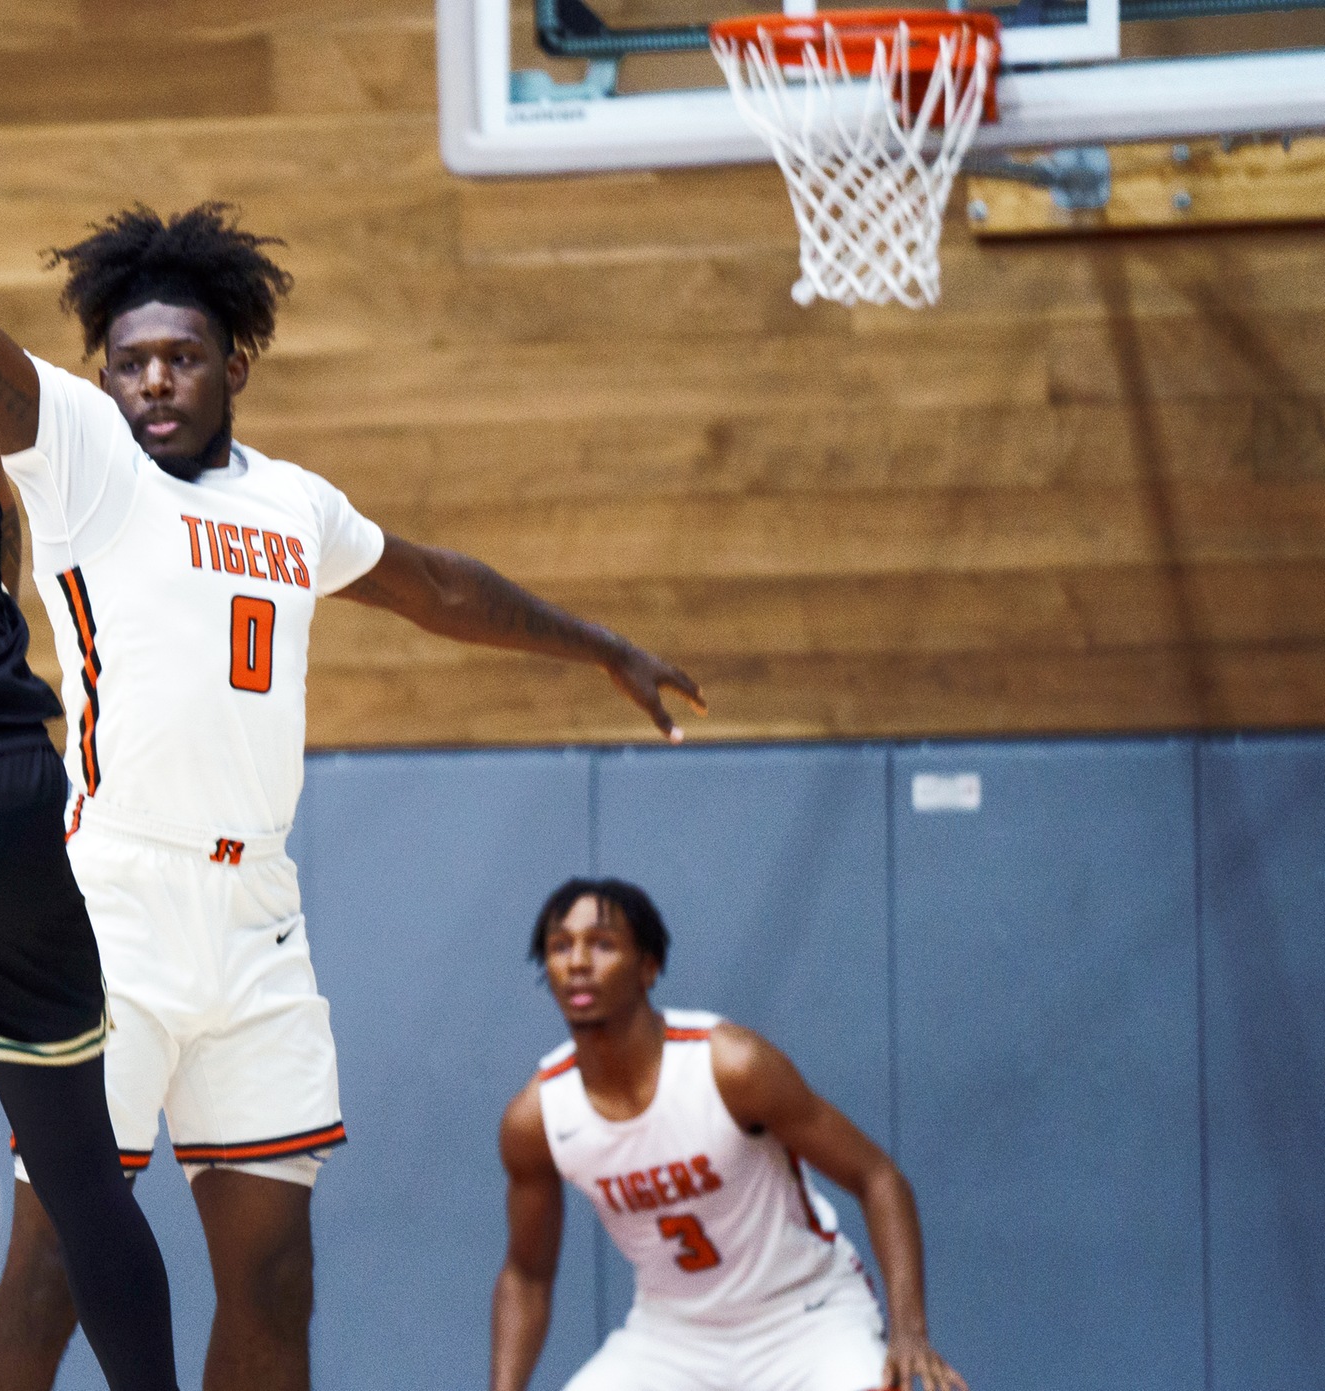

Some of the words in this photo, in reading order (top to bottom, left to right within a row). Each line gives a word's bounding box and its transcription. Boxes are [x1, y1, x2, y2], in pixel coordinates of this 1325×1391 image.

[181, 514, 311, 590] TIGERS
[229, 595, 276, 693] 0
[596, 1154, 724, 1214] TIGERS
[657, 1213, 722, 1274] 3
